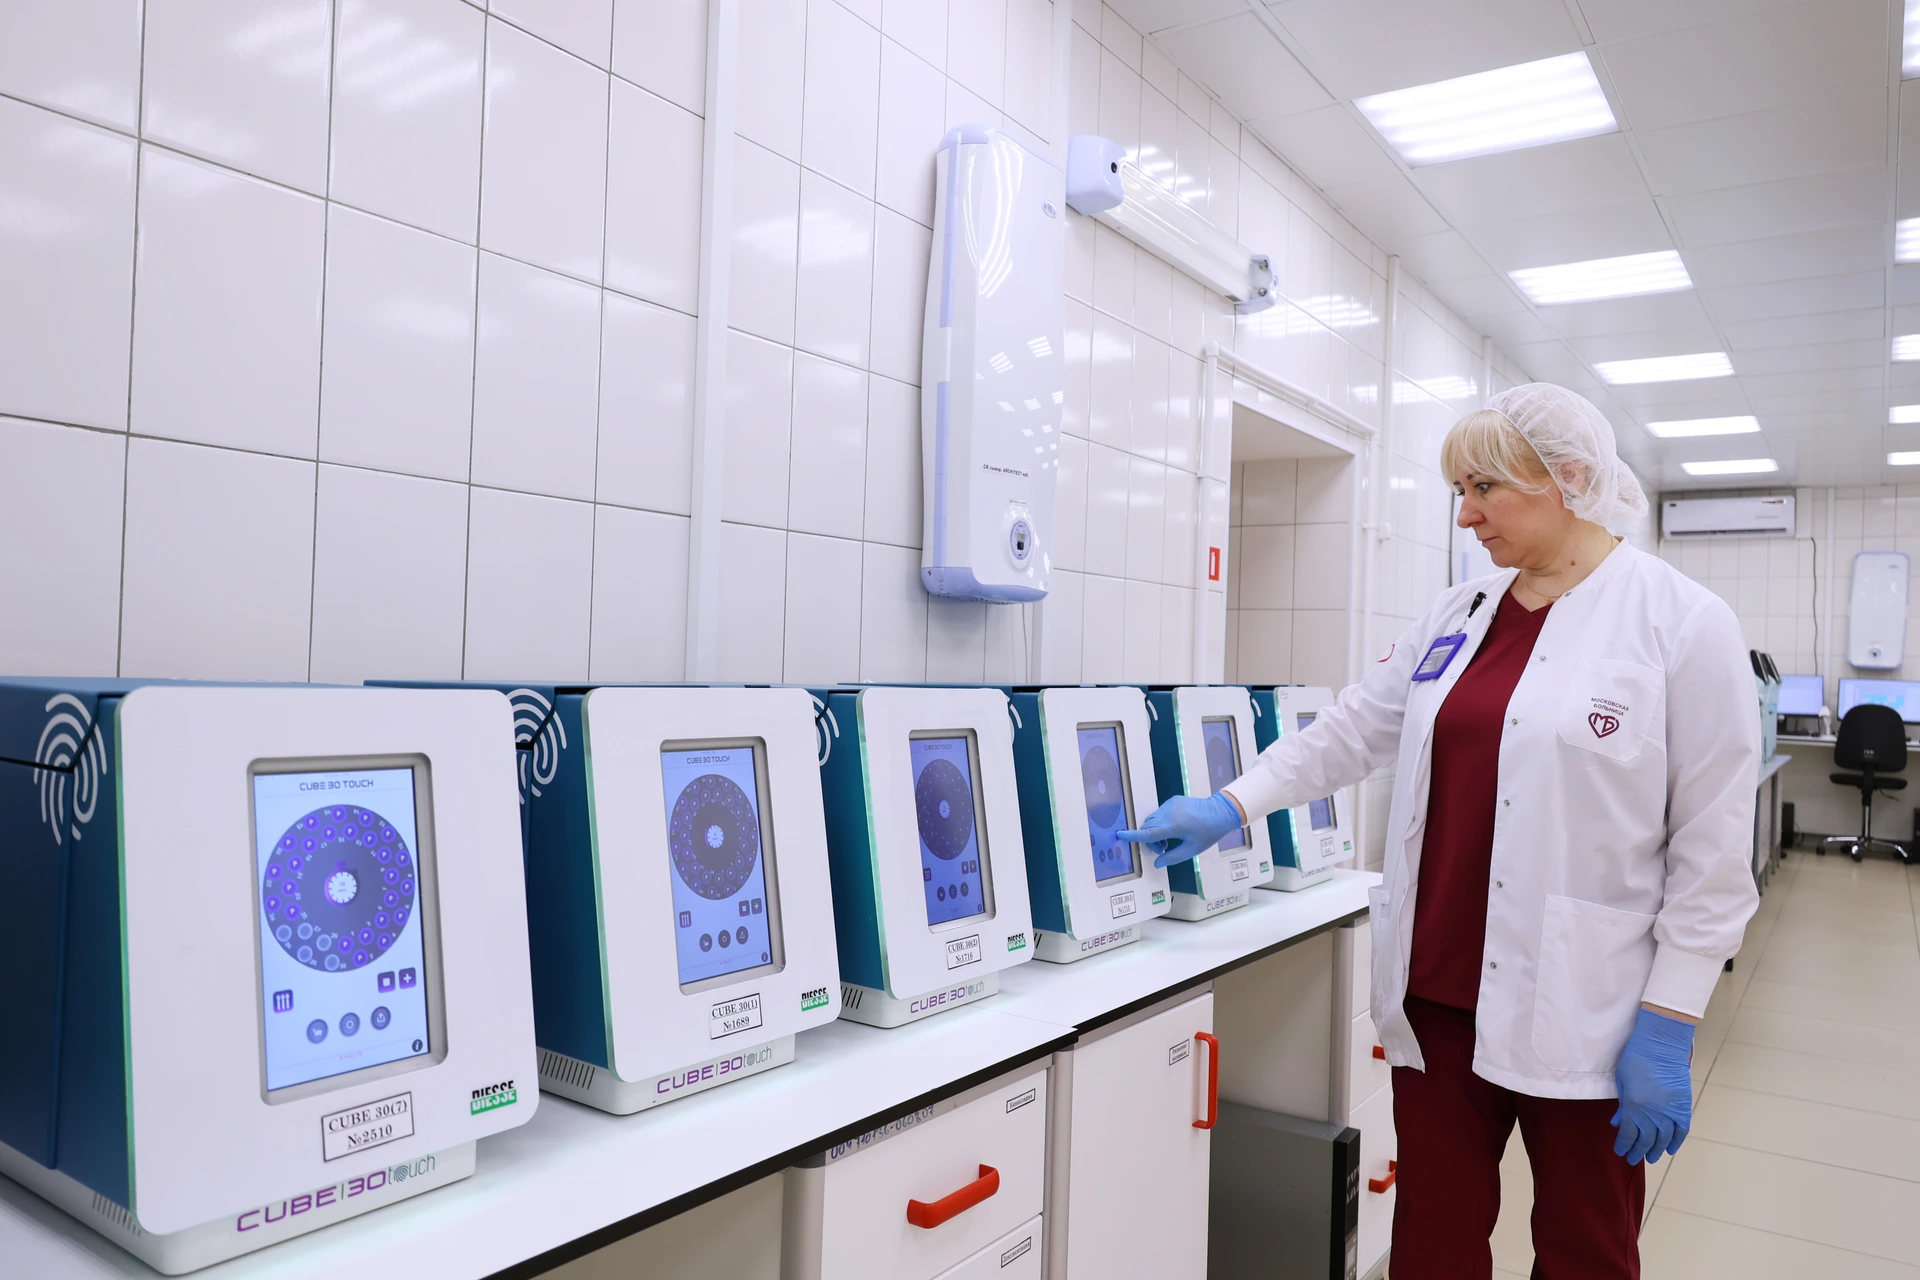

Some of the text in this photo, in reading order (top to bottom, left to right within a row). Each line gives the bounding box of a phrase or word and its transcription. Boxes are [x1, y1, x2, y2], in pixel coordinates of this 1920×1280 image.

[1591, 697, 1630, 712] МОСКОВСКАЯ
[1593, 703, 1624, 716] БОЛЬНИЦА
[686, 755, 731, 765] CUBE 30 TOUCH
[299, 779, 374, 791] CUBE 30 TOUCH
[948, 942, 964, 954] CUBE
[801, 987, 829, 1010] DIESSE
[711, 998, 759, 1019] CUBE 30(1)
[723, 1016, 750, 1032] №1689
[471, 1080, 517, 1112] DIESSE
[328, 1099, 409, 1134] CUBE 30(7)
[348, 1123, 394, 1149] №2510
